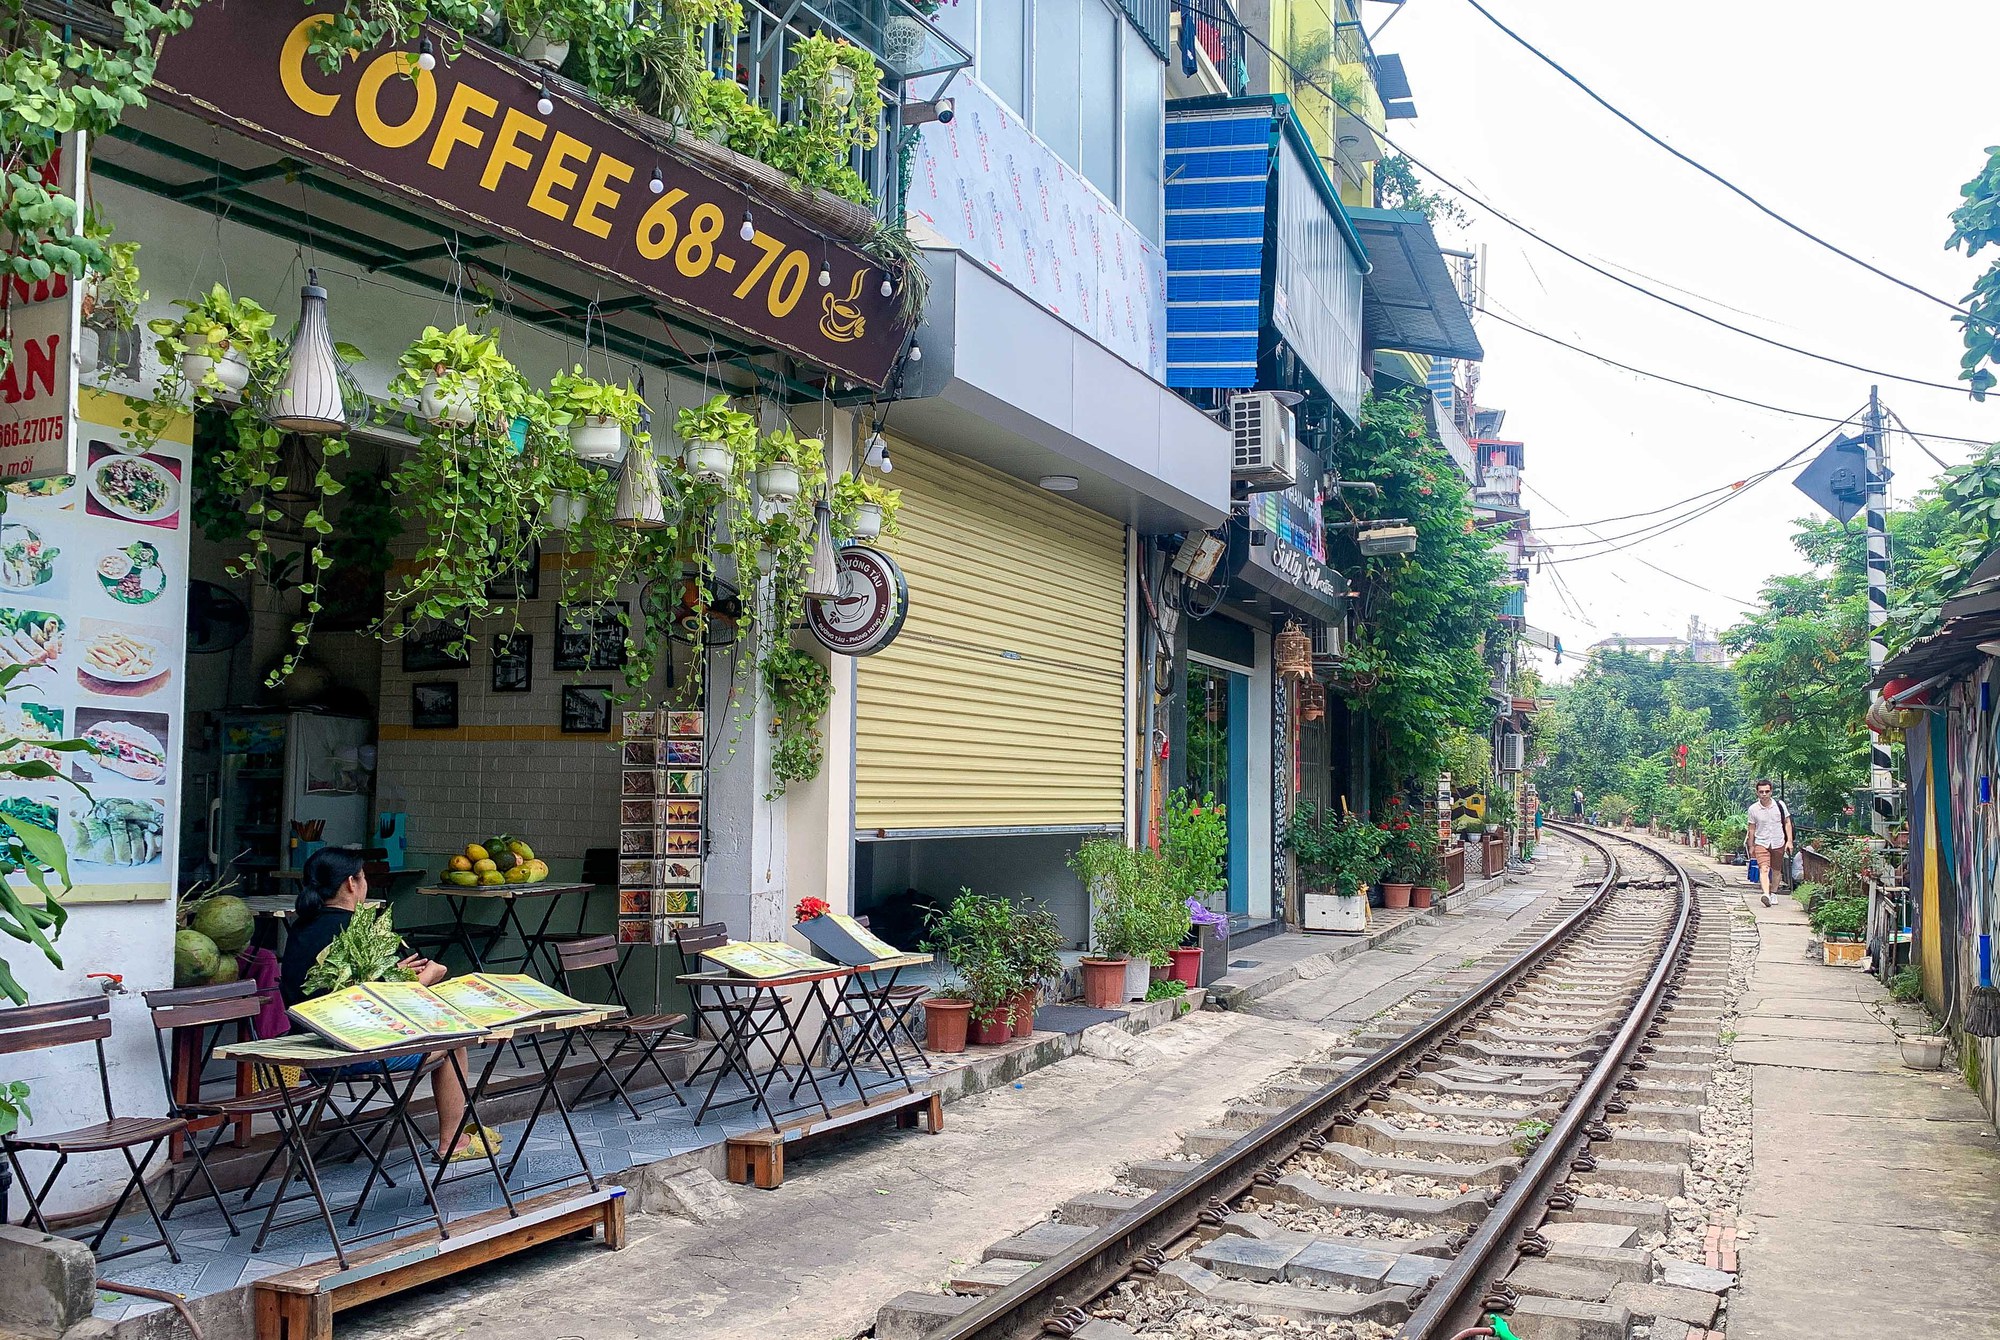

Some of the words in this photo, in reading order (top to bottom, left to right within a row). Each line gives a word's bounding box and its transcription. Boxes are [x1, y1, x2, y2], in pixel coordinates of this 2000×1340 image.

[280, 14, 634, 238] COFFEE
[636, 190, 809, 317] 68-70
[844, 557, 870, 573] ƯỜNG
[870, 569, 883, 588] TÀU
[880, 603, 886, 614] HN
